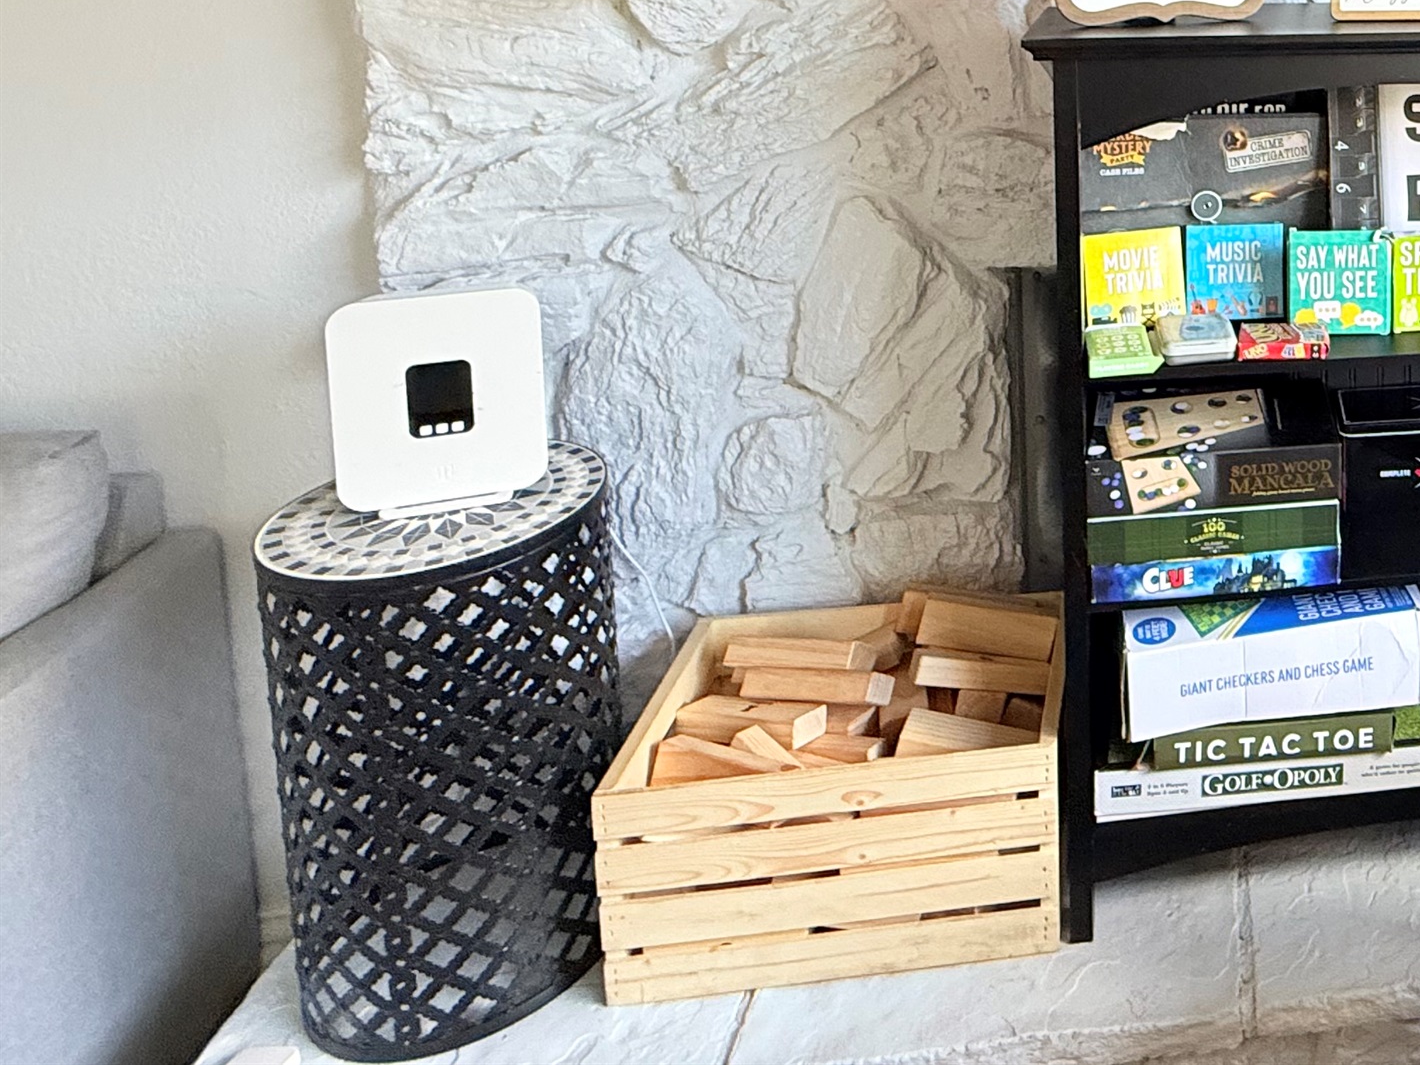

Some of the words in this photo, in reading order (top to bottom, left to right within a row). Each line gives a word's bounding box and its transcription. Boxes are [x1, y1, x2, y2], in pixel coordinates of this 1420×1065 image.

[1093, 140, 1152, 155] MYSTERY
[1229, 145, 1308, 167] INVESTIGATION
[1250, 138, 1284, 152] CRIME
[1334, 140, 1350, 151] 4
[1110, 155, 1135, 164] PARTY
[1335, 182, 1352, 194] 6
[1103, 246, 1160, 272] MOVIE
[1206, 240, 1262, 262] MUSIC
[1296, 245, 1328, 269] SAY
[1333, 244, 1380, 268] WHAT
[1105, 267, 1164, 295] TRIVIA
[1206, 263, 1264, 285] TRIVIA
[1296, 271, 1335, 300] YOU
[1341, 270, 1378, 298] SEE
[1230, 463, 1278, 477] SOLID
[1281, 459, 1332, 474] WOOD
[1228, 472, 1335, 495] MANCALA
[1202, 521, 1226, 533] 100
[1142, 566, 1194, 594] CLUE
[1180, 679, 1213, 697] GIANT
[1216, 670, 1275, 691] CHECKERS
[1277, 666, 1301, 682] AND
[1304, 661, 1340, 678] CHESS
[1342, 656, 1374, 673] GAME
[1174, 739, 1227, 764] TIC
[1238, 733, 1301, 758] TAC
[1312, 727, 1374, 752] TOE
